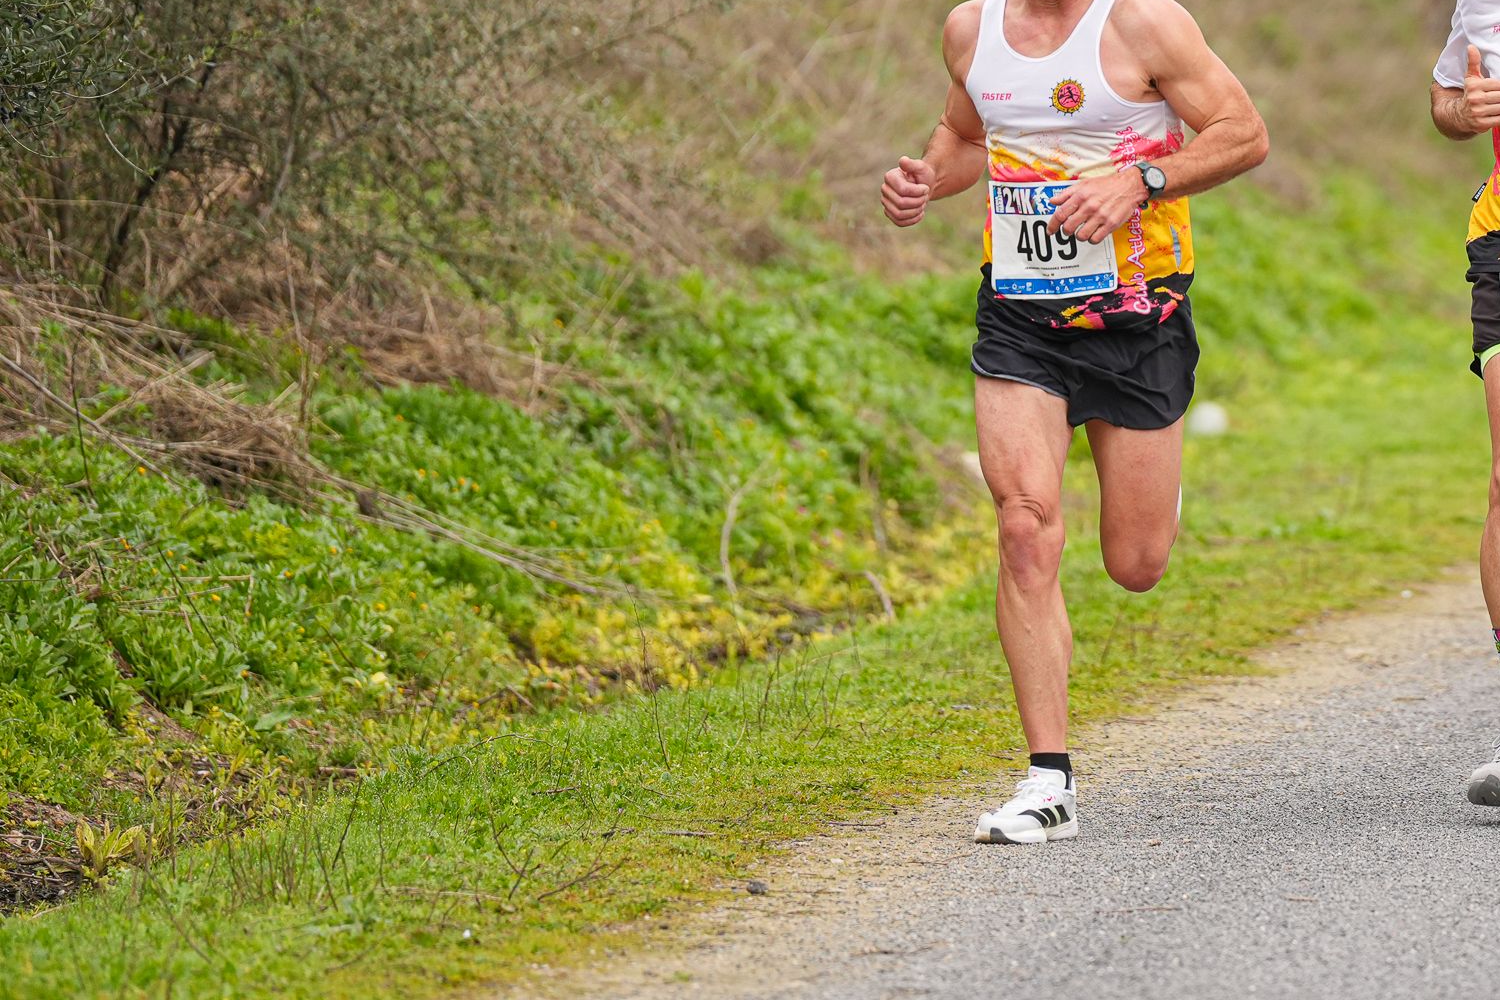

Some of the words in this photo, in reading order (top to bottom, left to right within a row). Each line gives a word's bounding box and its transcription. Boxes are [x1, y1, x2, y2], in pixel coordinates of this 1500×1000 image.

[981, 92, 1012, 101] FASTER
[1016, 219, 1078, 262] 409
[1127, 205, 1146, 269] Atletis
[1130, 271, 1152, 316] Club
